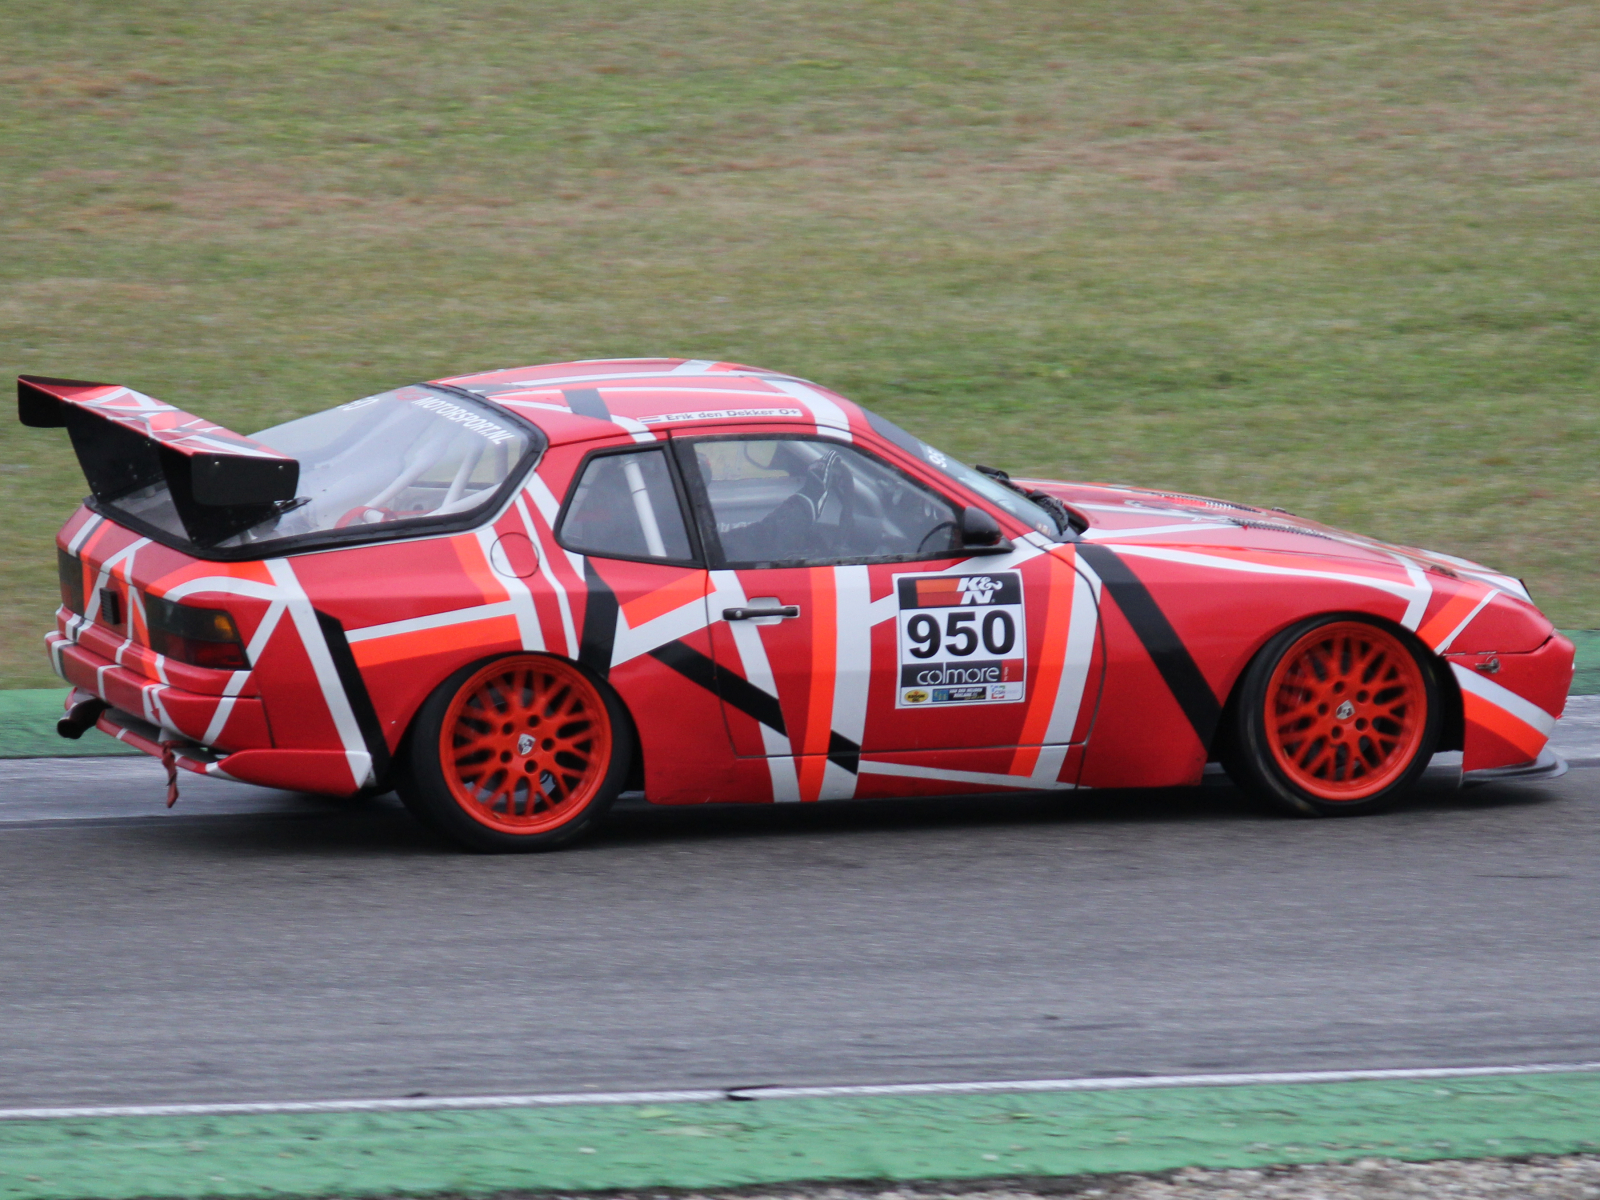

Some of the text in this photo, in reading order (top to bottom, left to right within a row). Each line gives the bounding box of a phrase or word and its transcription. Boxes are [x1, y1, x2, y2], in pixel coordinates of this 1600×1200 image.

[726, 408, 775, 417] Dekker
[907, 609, 1015, 659] 950
[916, 662, 1000, 685] colmore
